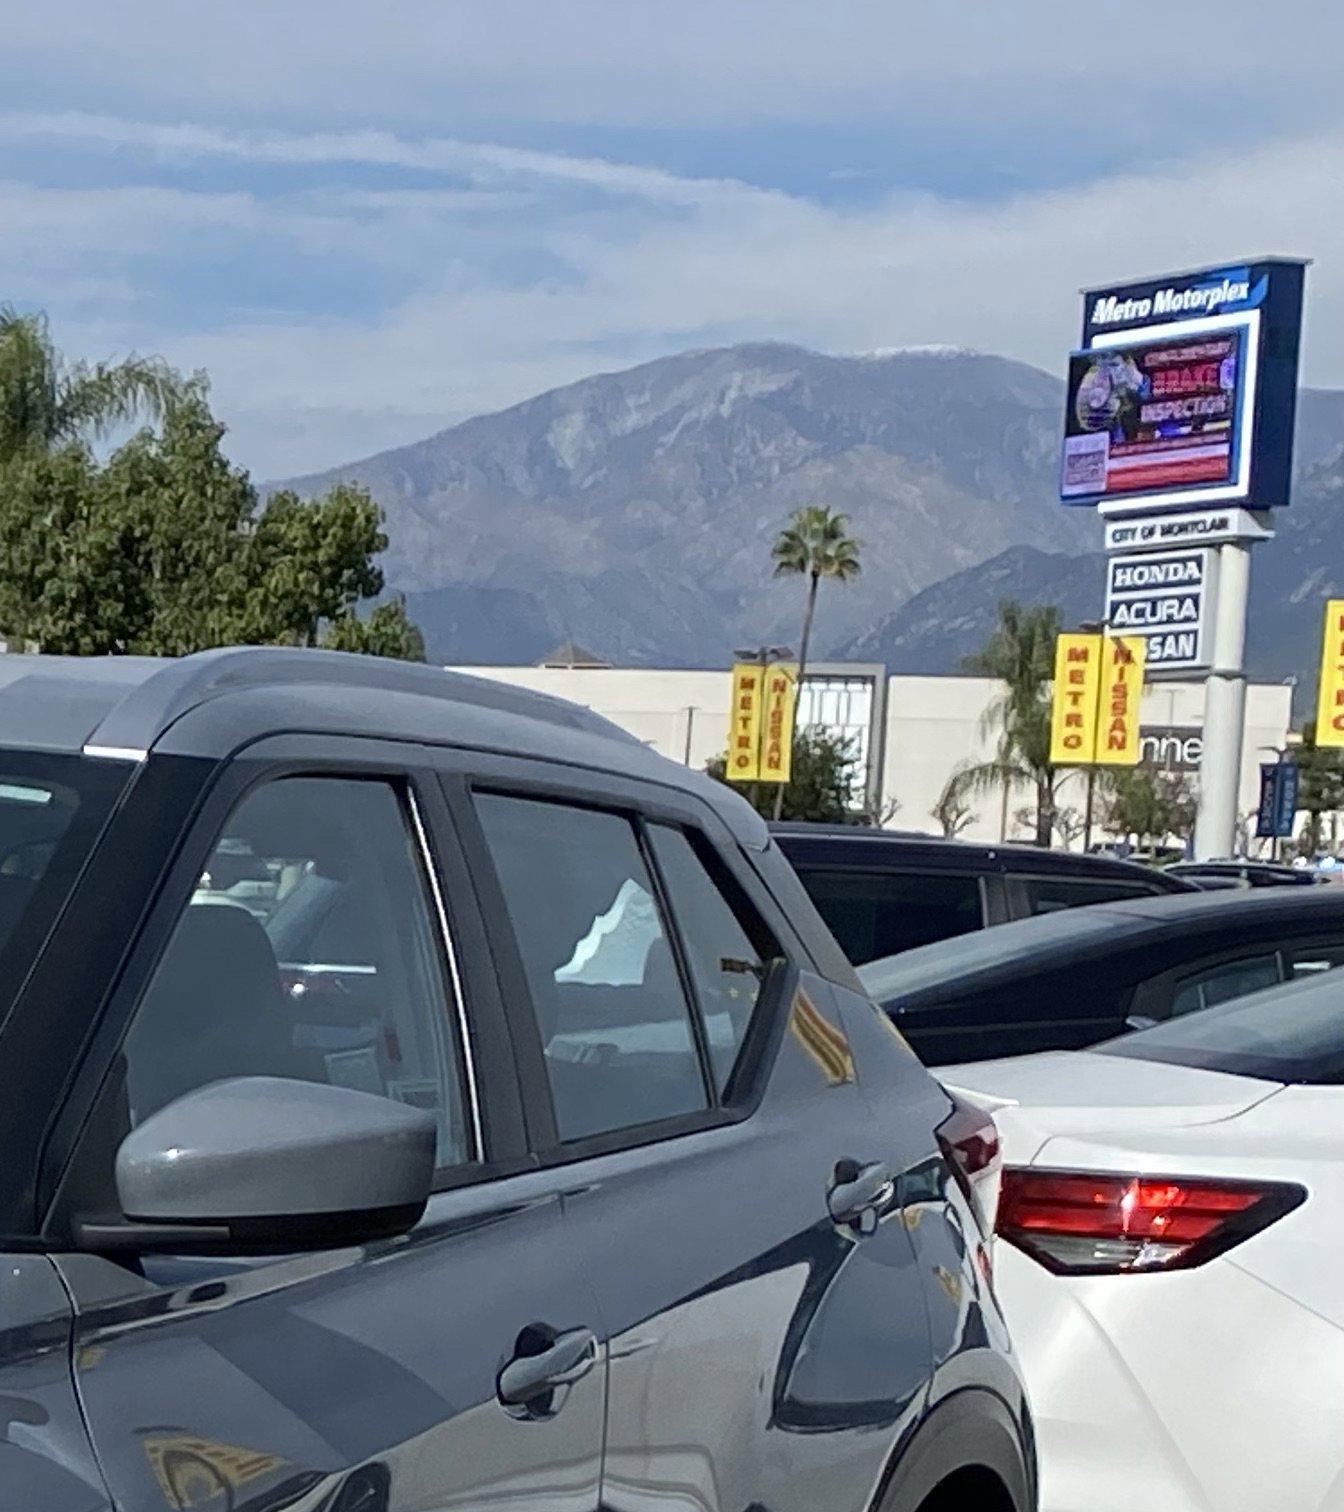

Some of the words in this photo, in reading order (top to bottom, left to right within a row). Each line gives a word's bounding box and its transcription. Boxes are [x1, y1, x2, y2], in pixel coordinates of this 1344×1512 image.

[1091, 296, 1151, 323] Metro
[1153, 280, 1250, 314] Motorplex
[1112, 526, 1137, 544] CITY
[1114, 561, 1202, 587] HONDA
[1113, 598, 1197, 625] ACURA
[1148, 632, 1196, 660] SAN
[1063, 647, 1089, 750] METRO
[1108, 647, 1132, 751] NISSAN
[736, 676, 755, 769] METRO
[767, 678, 787, 770] NISSAN
